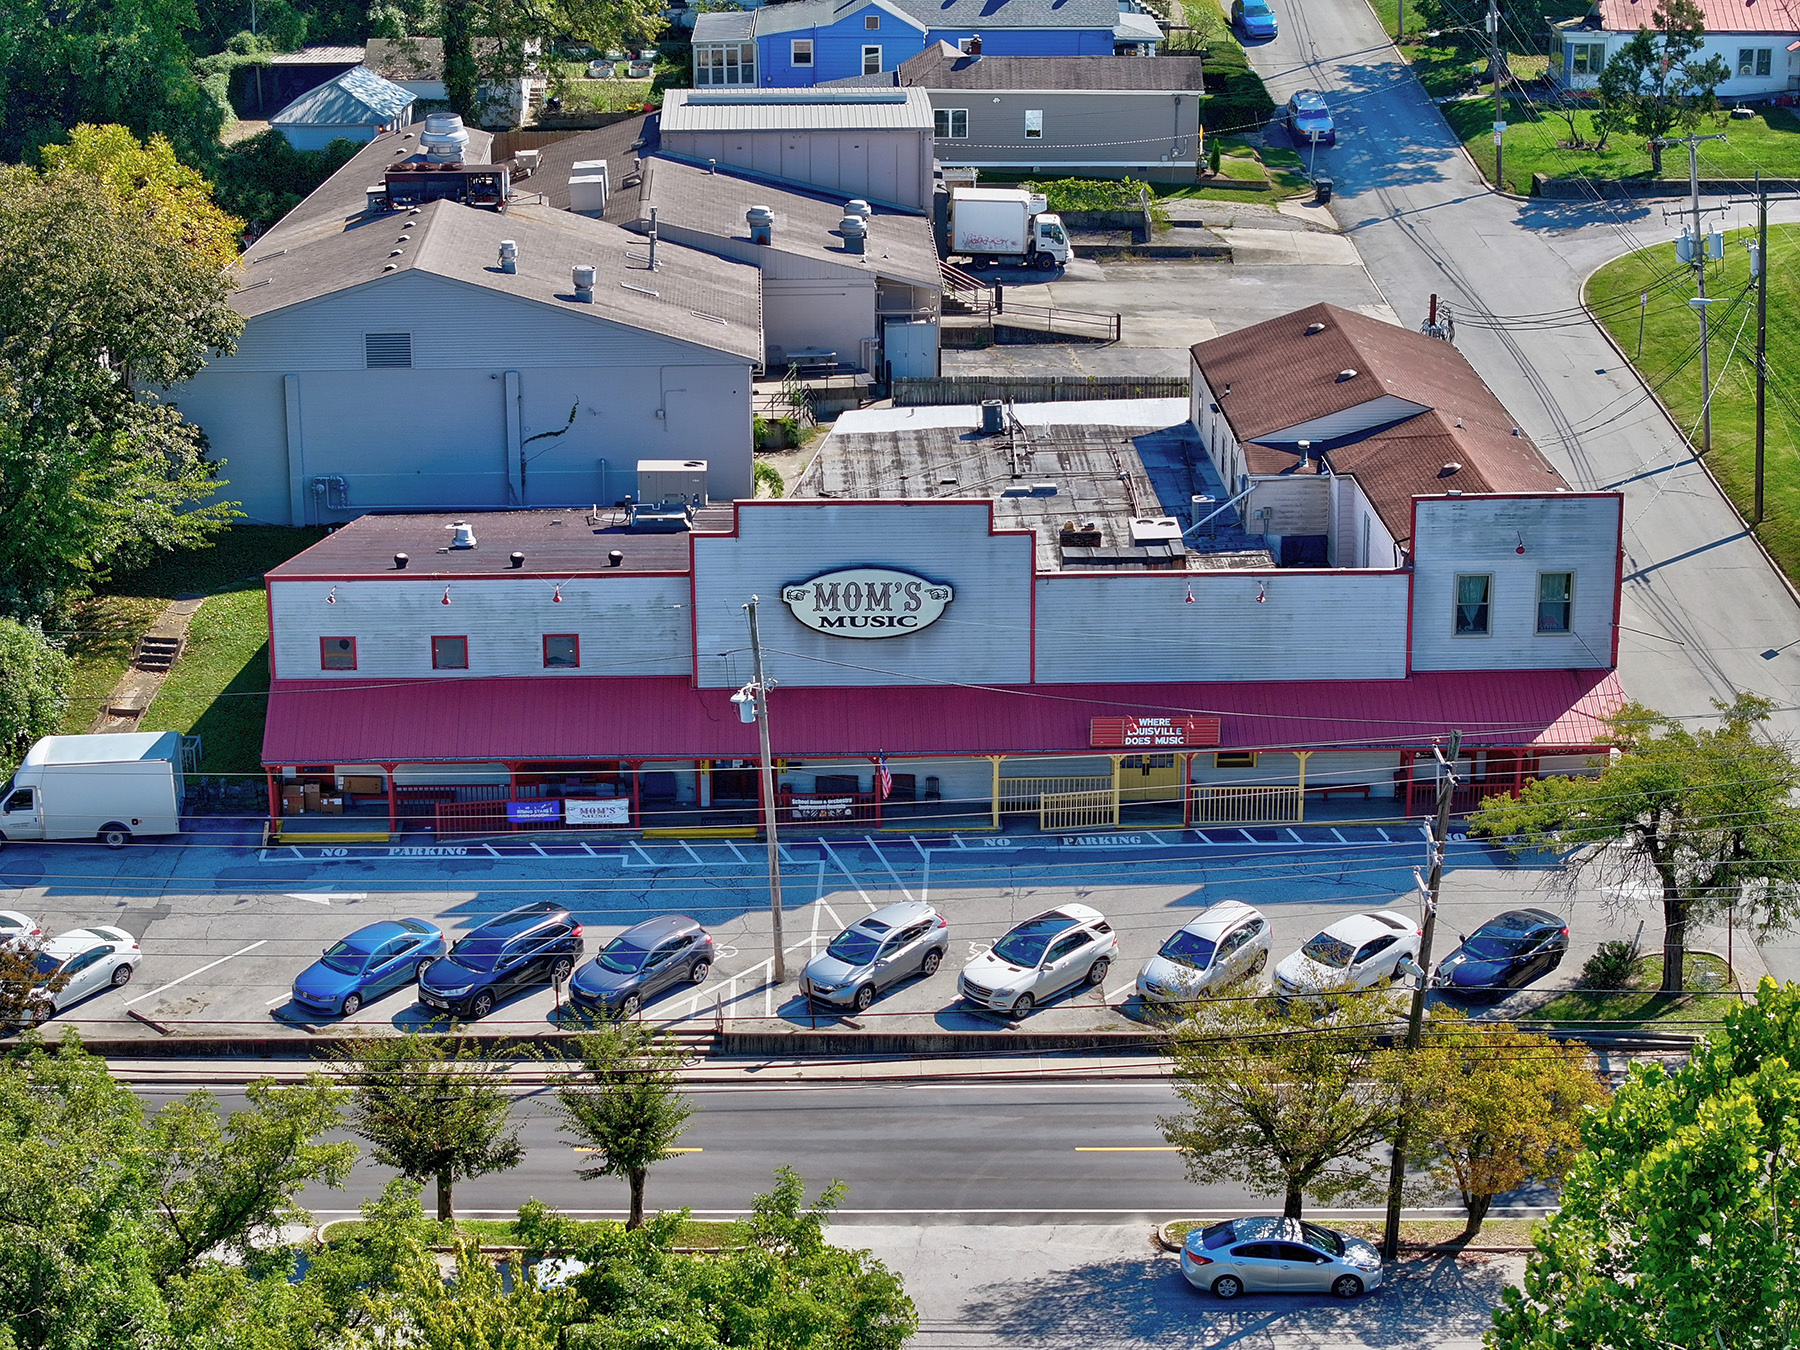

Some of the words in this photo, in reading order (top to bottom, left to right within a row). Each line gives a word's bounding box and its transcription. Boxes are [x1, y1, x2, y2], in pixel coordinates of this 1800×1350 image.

[812, 581, 922, 612] MOM'S
[818, 616, 918, 628] MUSIC
[1138, 718, 1171, 726] WHERE
[1125, 736, 1151, 745] DOES
[1155, 736, 1184, 745] MUSIC
[580, 806, 616, 815] MOM'S
[983, 838, 1011, 846] NO
[1062, 836, 1141, 845] PARKING
[320, 848, 349, 857] NO
[388, 847, 467, 856] PARKING
